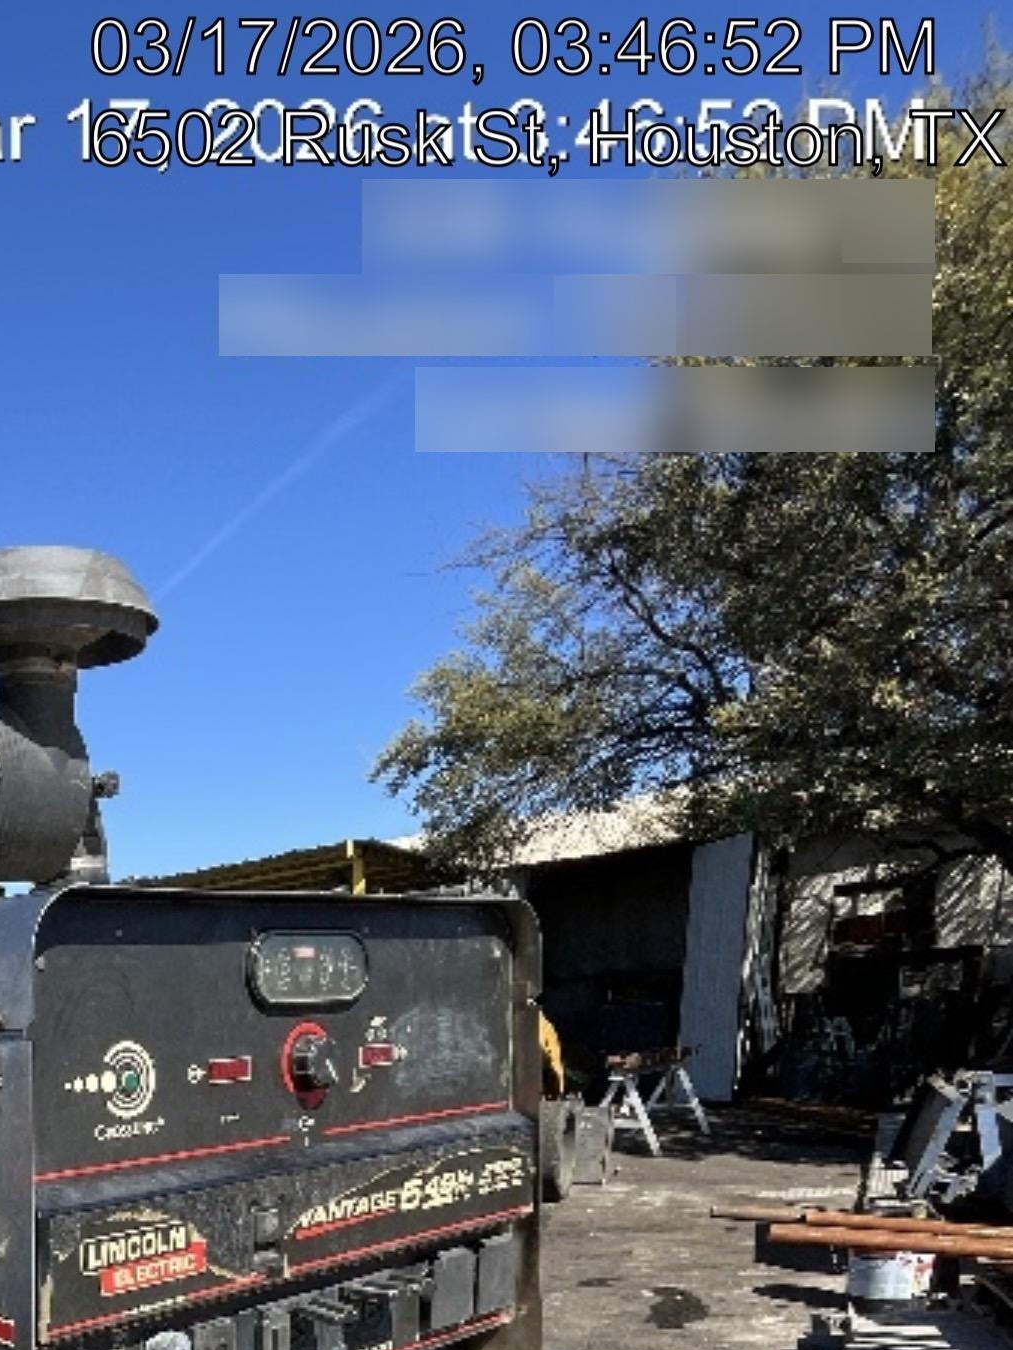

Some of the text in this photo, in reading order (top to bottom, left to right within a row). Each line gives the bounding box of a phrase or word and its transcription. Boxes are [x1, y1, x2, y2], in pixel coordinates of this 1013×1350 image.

[298, 1189, 397, 1228] VANTAGE
[88, 1225, 187, 1271] LINCOLN
[113, 1252, 197, 1289] ELECTRIC
